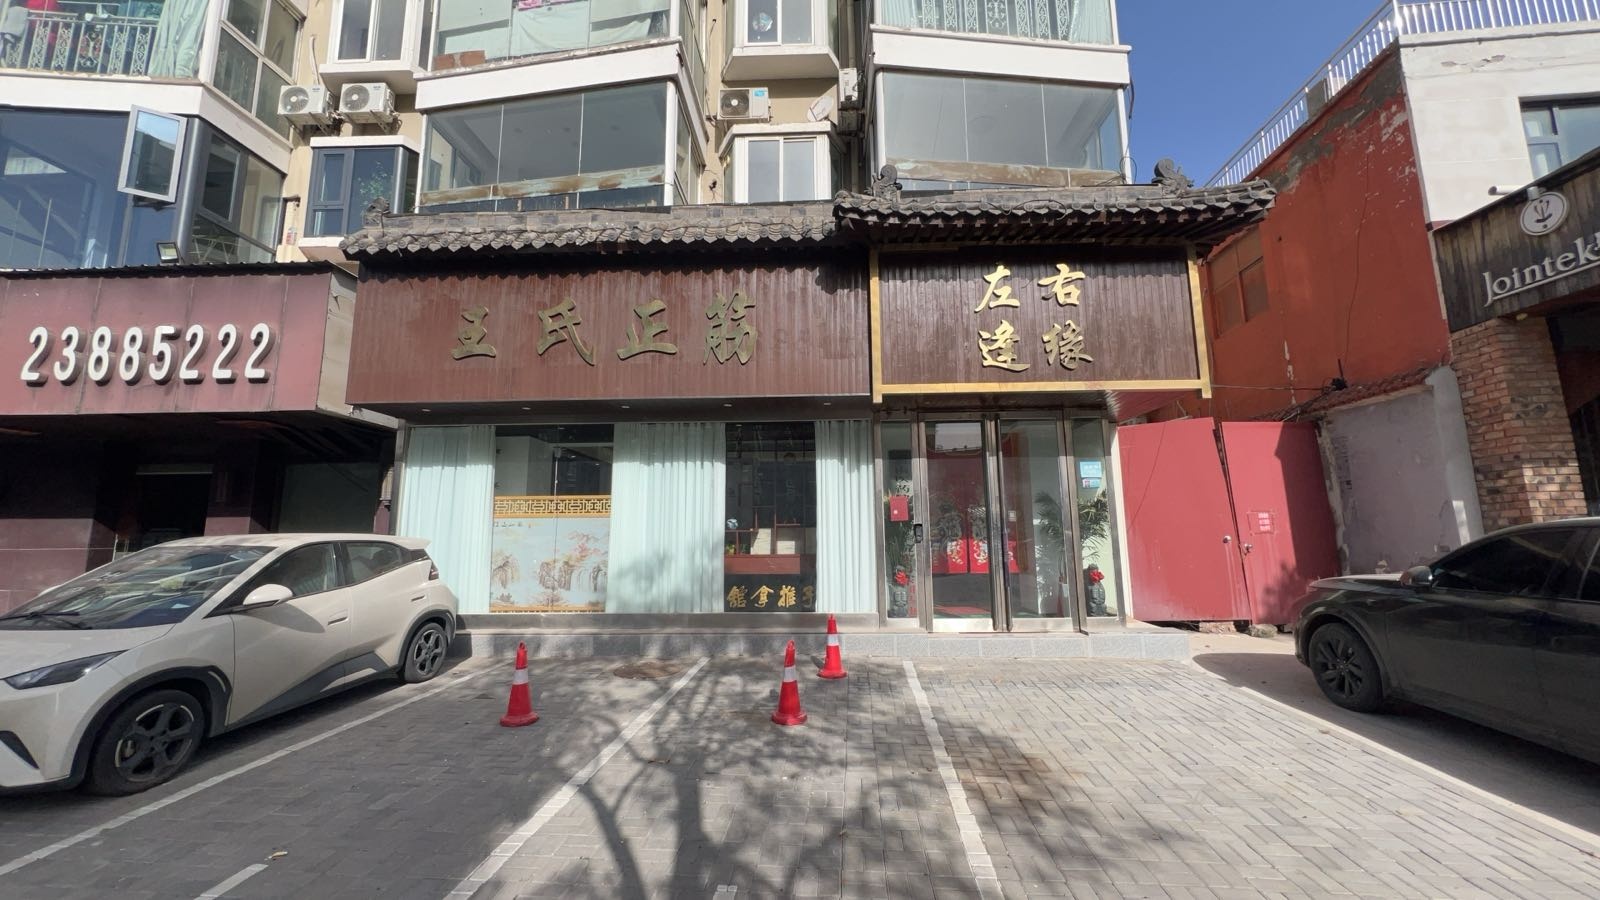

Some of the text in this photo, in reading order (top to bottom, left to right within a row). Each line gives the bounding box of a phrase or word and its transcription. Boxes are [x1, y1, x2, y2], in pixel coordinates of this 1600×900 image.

[974, 263, 1086, 313] 左右
[1482, 231, 1600, 307] Jointek
[20, 322, 272, 386] 23885222
[451, 290, 758, 366] 王氏正筋
